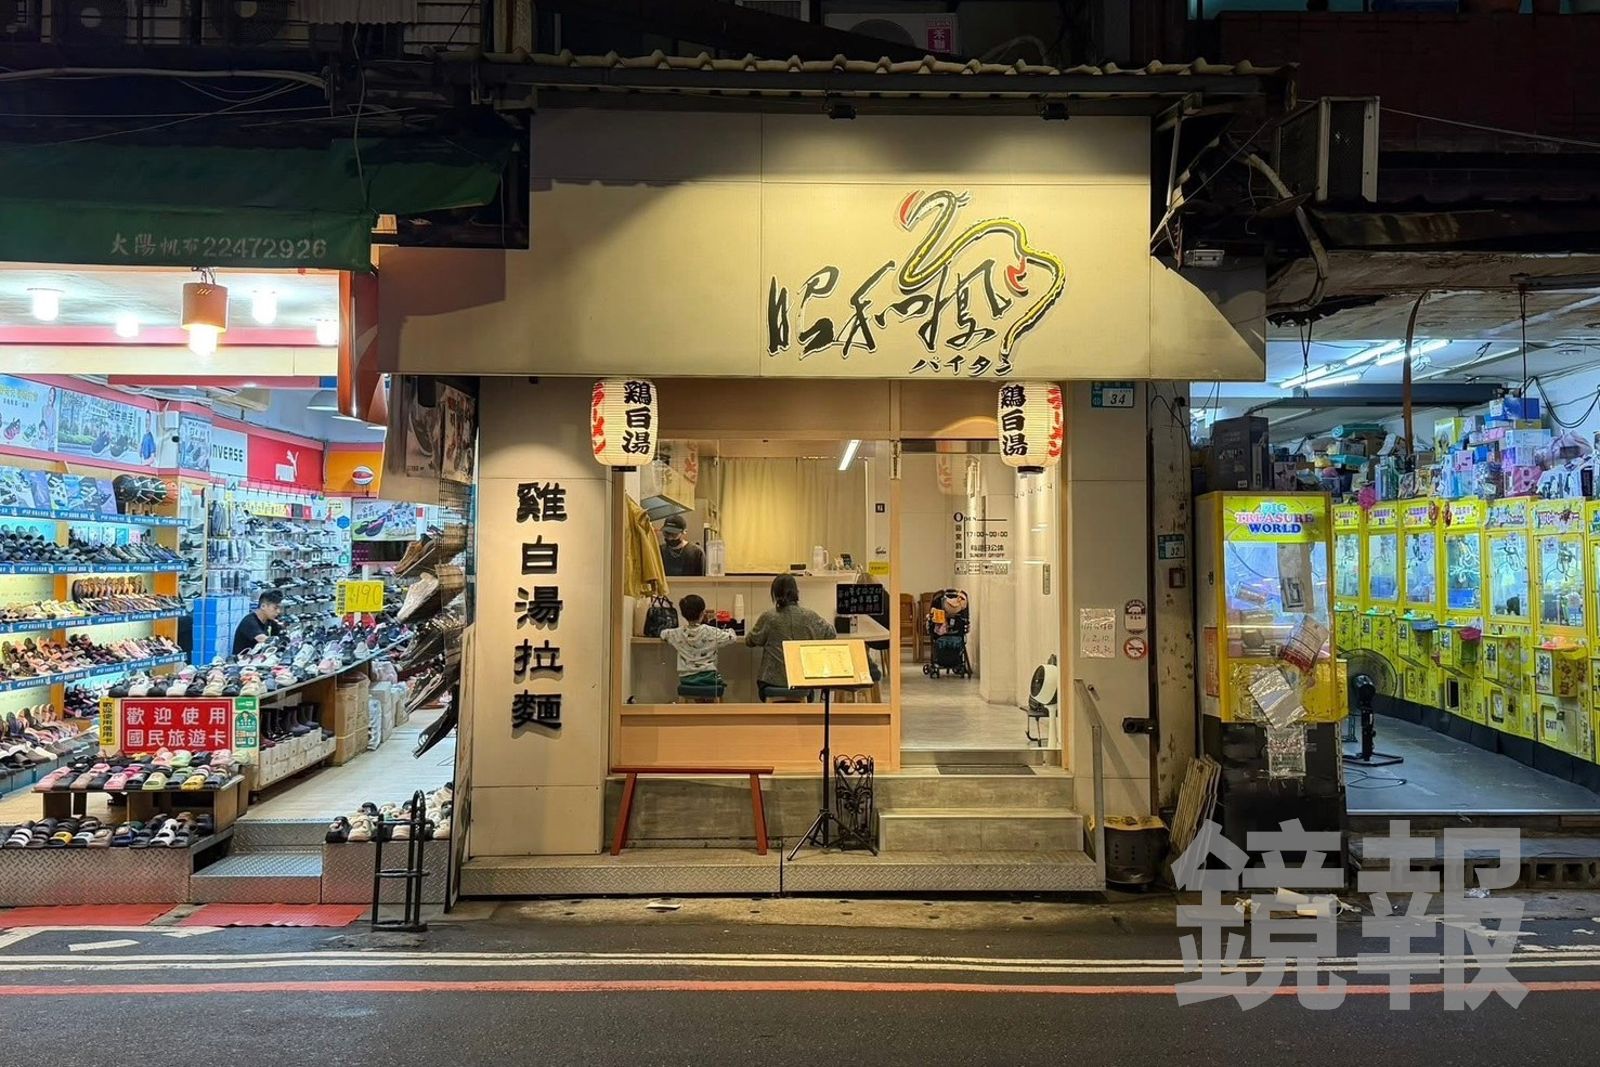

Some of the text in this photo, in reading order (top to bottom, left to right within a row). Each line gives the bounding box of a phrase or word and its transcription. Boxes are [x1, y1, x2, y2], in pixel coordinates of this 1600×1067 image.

[202, 235, 328, 259] 22472926
[1110, 393, 1126, 405] 34
[208, 442, 244, 463] NVERSE
[1236, 513, 1314, 523] TREASURE
[1249, 523, 1302, 533] WORLD
[511, 482, 567, 735] 雞白湯拉麵
[126, 706, 226, 725] 歡迎使用
[1546, 719, 1557, 730] EXIT
[126, 729, 227, 748] 國民旅遊卡
